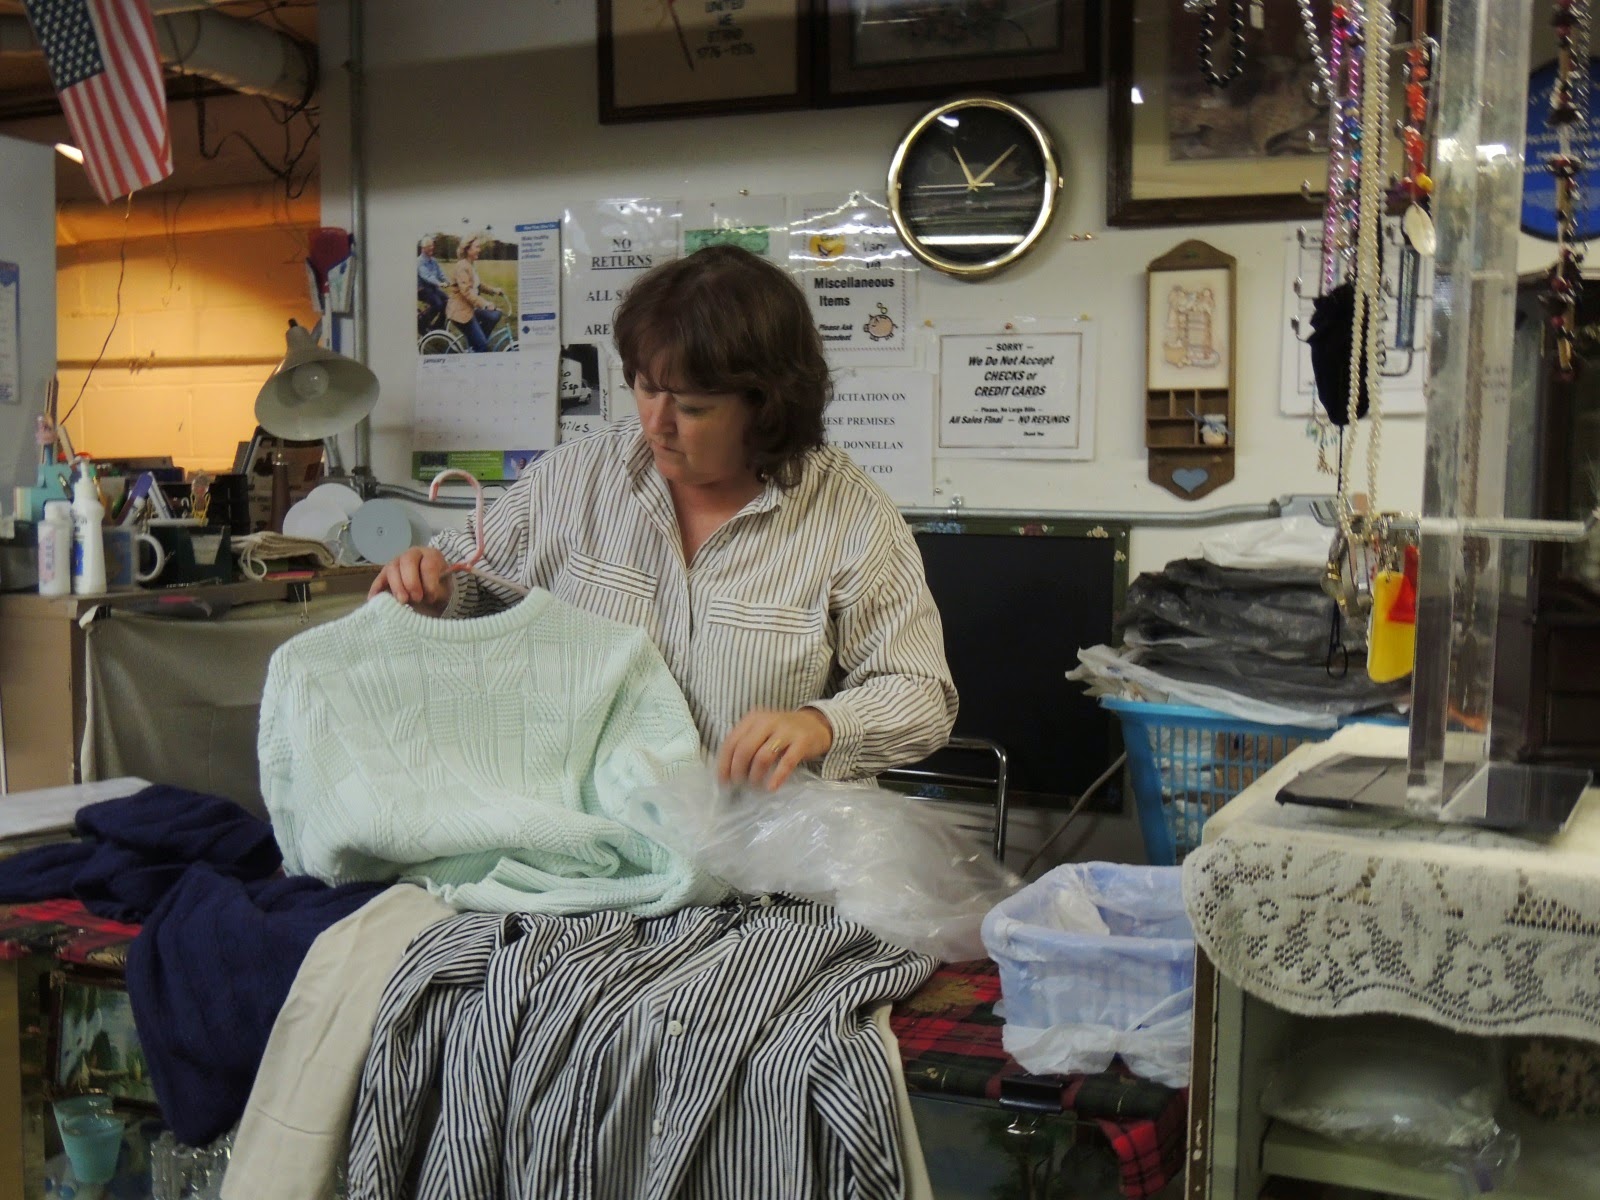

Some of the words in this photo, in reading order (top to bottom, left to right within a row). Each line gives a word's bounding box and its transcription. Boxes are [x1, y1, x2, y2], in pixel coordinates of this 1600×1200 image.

[613, 238, 632, 250] NO
[591, 254, 653, 268] RETURNS
[814, 276, 895, 289] Miscellaneous
[586, 290, 613, 302] ALL
[819, 295, 851, 307] Items
[584, 324, 611, 336] ARE
[996, 343, 1023, 352] SORRY
[968, 356, 983, 366] We
[985, 356, 998, 366] Do
[999, 355, 1018, 366] Not
[1020, 355, 1055, 367] Accept
[984, 371, 1025, 382] CHECKS
[1026, 372, 1038, 381] or
[832, 393, 889, 402] LICITATION
[891, 392, 906, 402] ON
[974, 386, 1009, 397] CREDIT
[1011, 385, 1046, 397] CARDS
[847, 416, 896, 425] PREMISES
[949, 415, 960, 424] All
[961, 415, 983, 424] Sales
[984, 415, 1003, 424] Final
[1018, 415, 1031, 424] NO
[1031, 415, 1071, 424] REFUNDS
[843, 440, 905, 450] DONNELLAN
